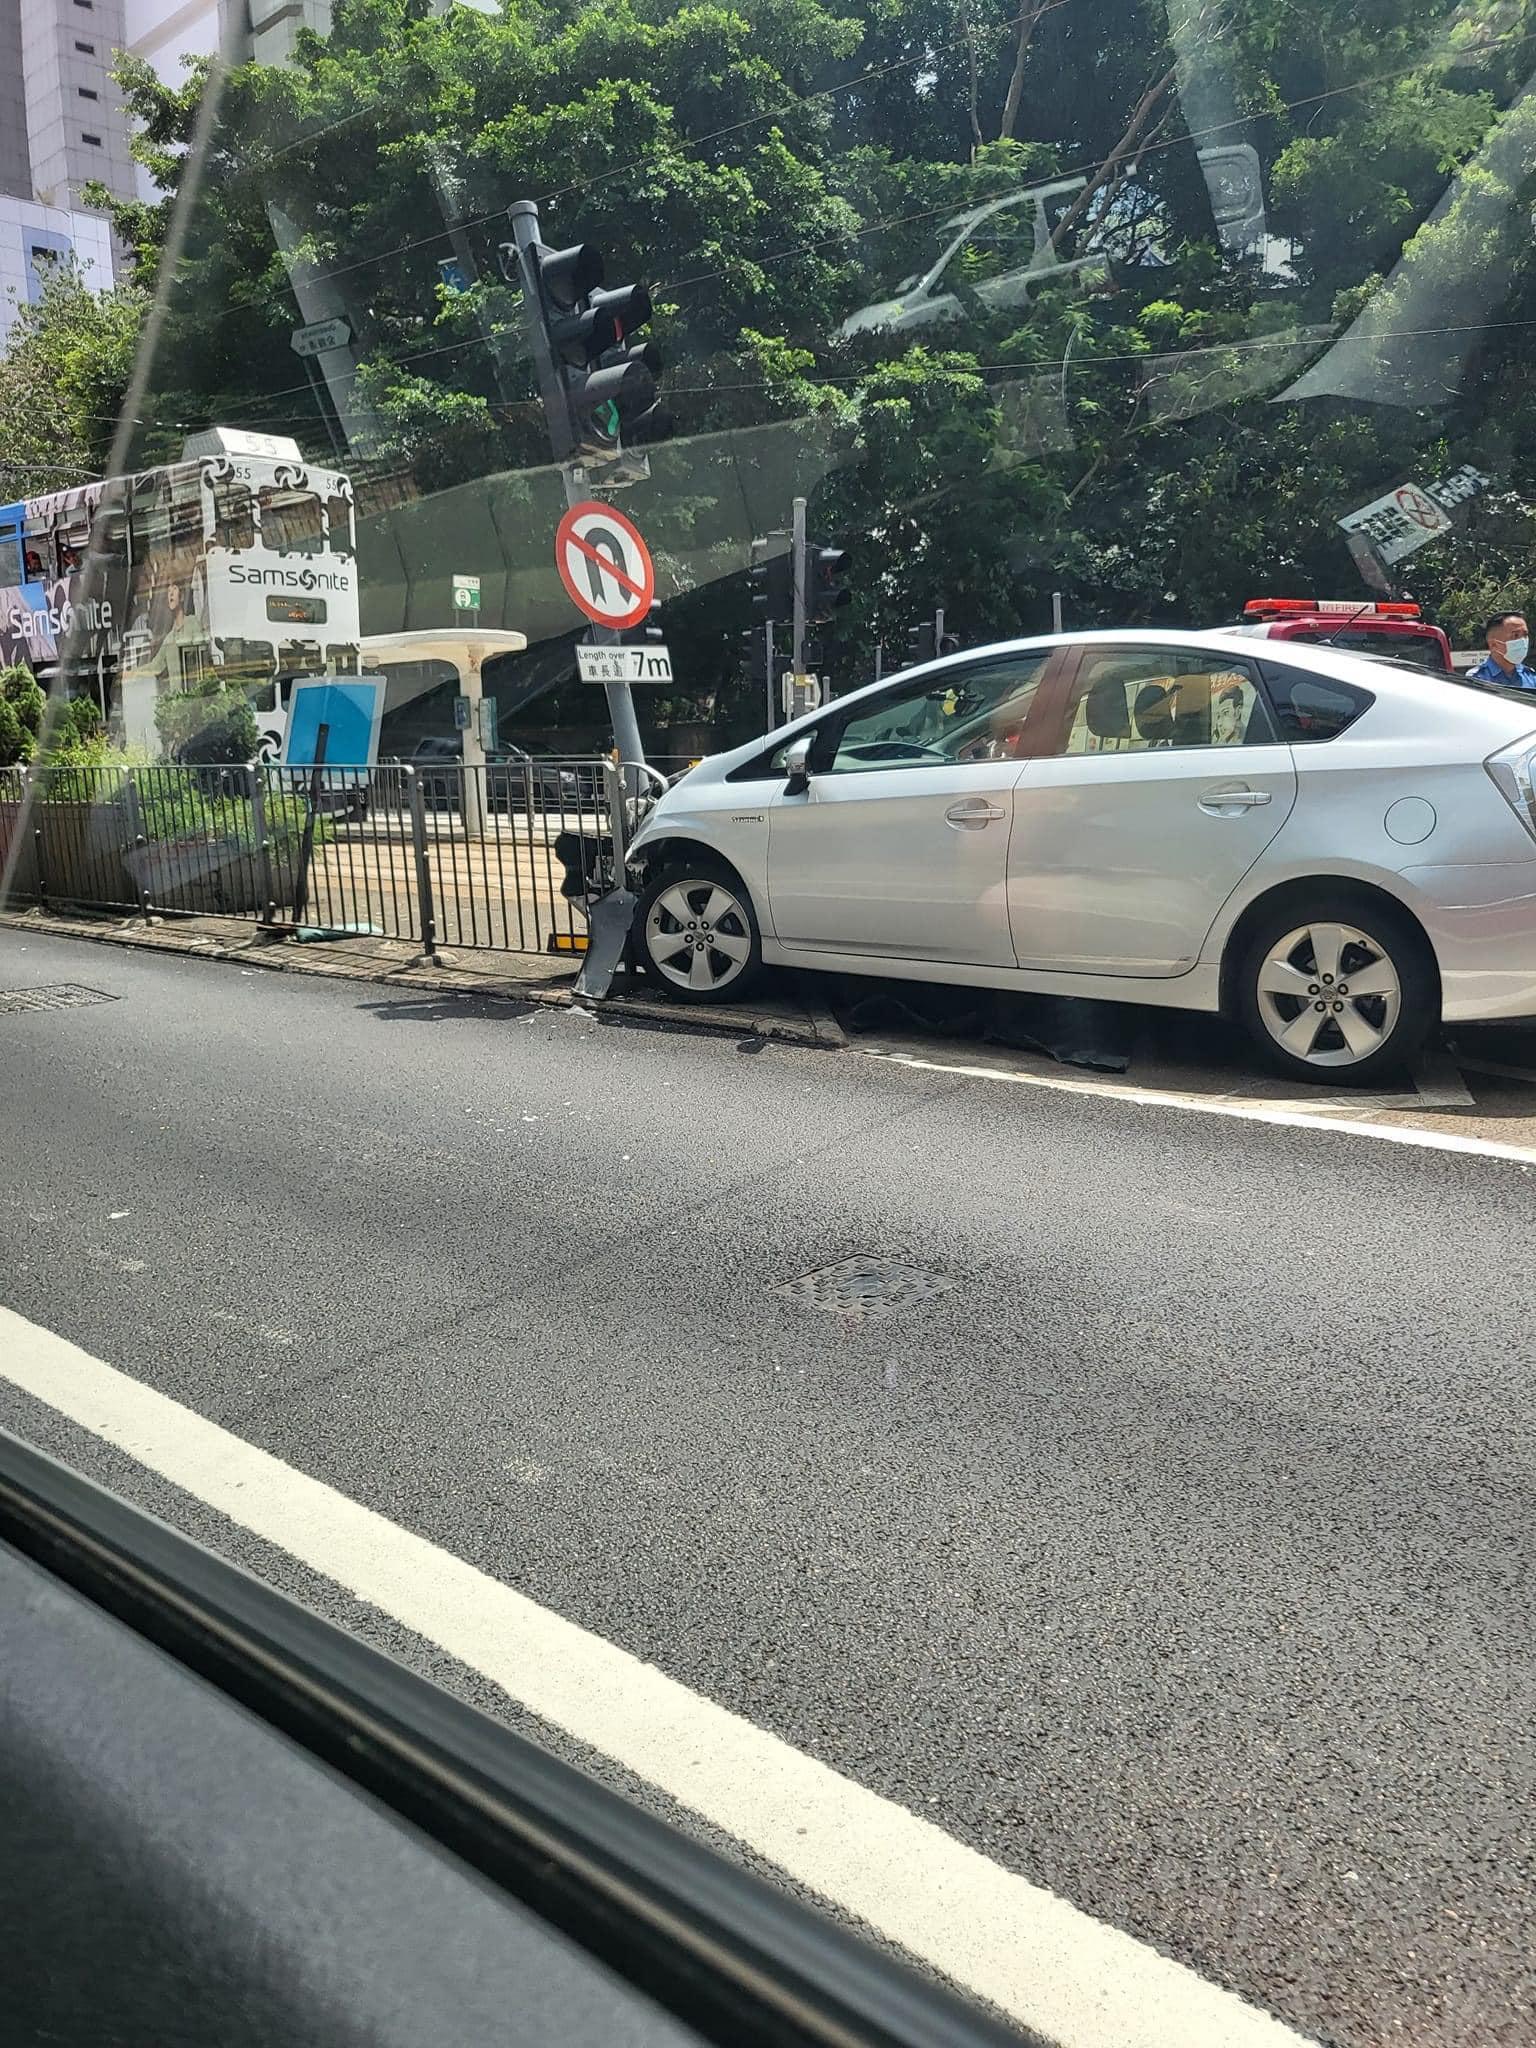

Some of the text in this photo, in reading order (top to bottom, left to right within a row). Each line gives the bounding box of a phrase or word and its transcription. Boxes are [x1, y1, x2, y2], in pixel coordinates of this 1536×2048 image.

[245, 434, 277, 455] 55
[235, 467, 251, 480] 55
[326, 478, 337, 491] 55
[228, 565, 349, 592] Samsonite
[579, 650, 625, 662] Length over
[631, 651, 671, 677] 7m
